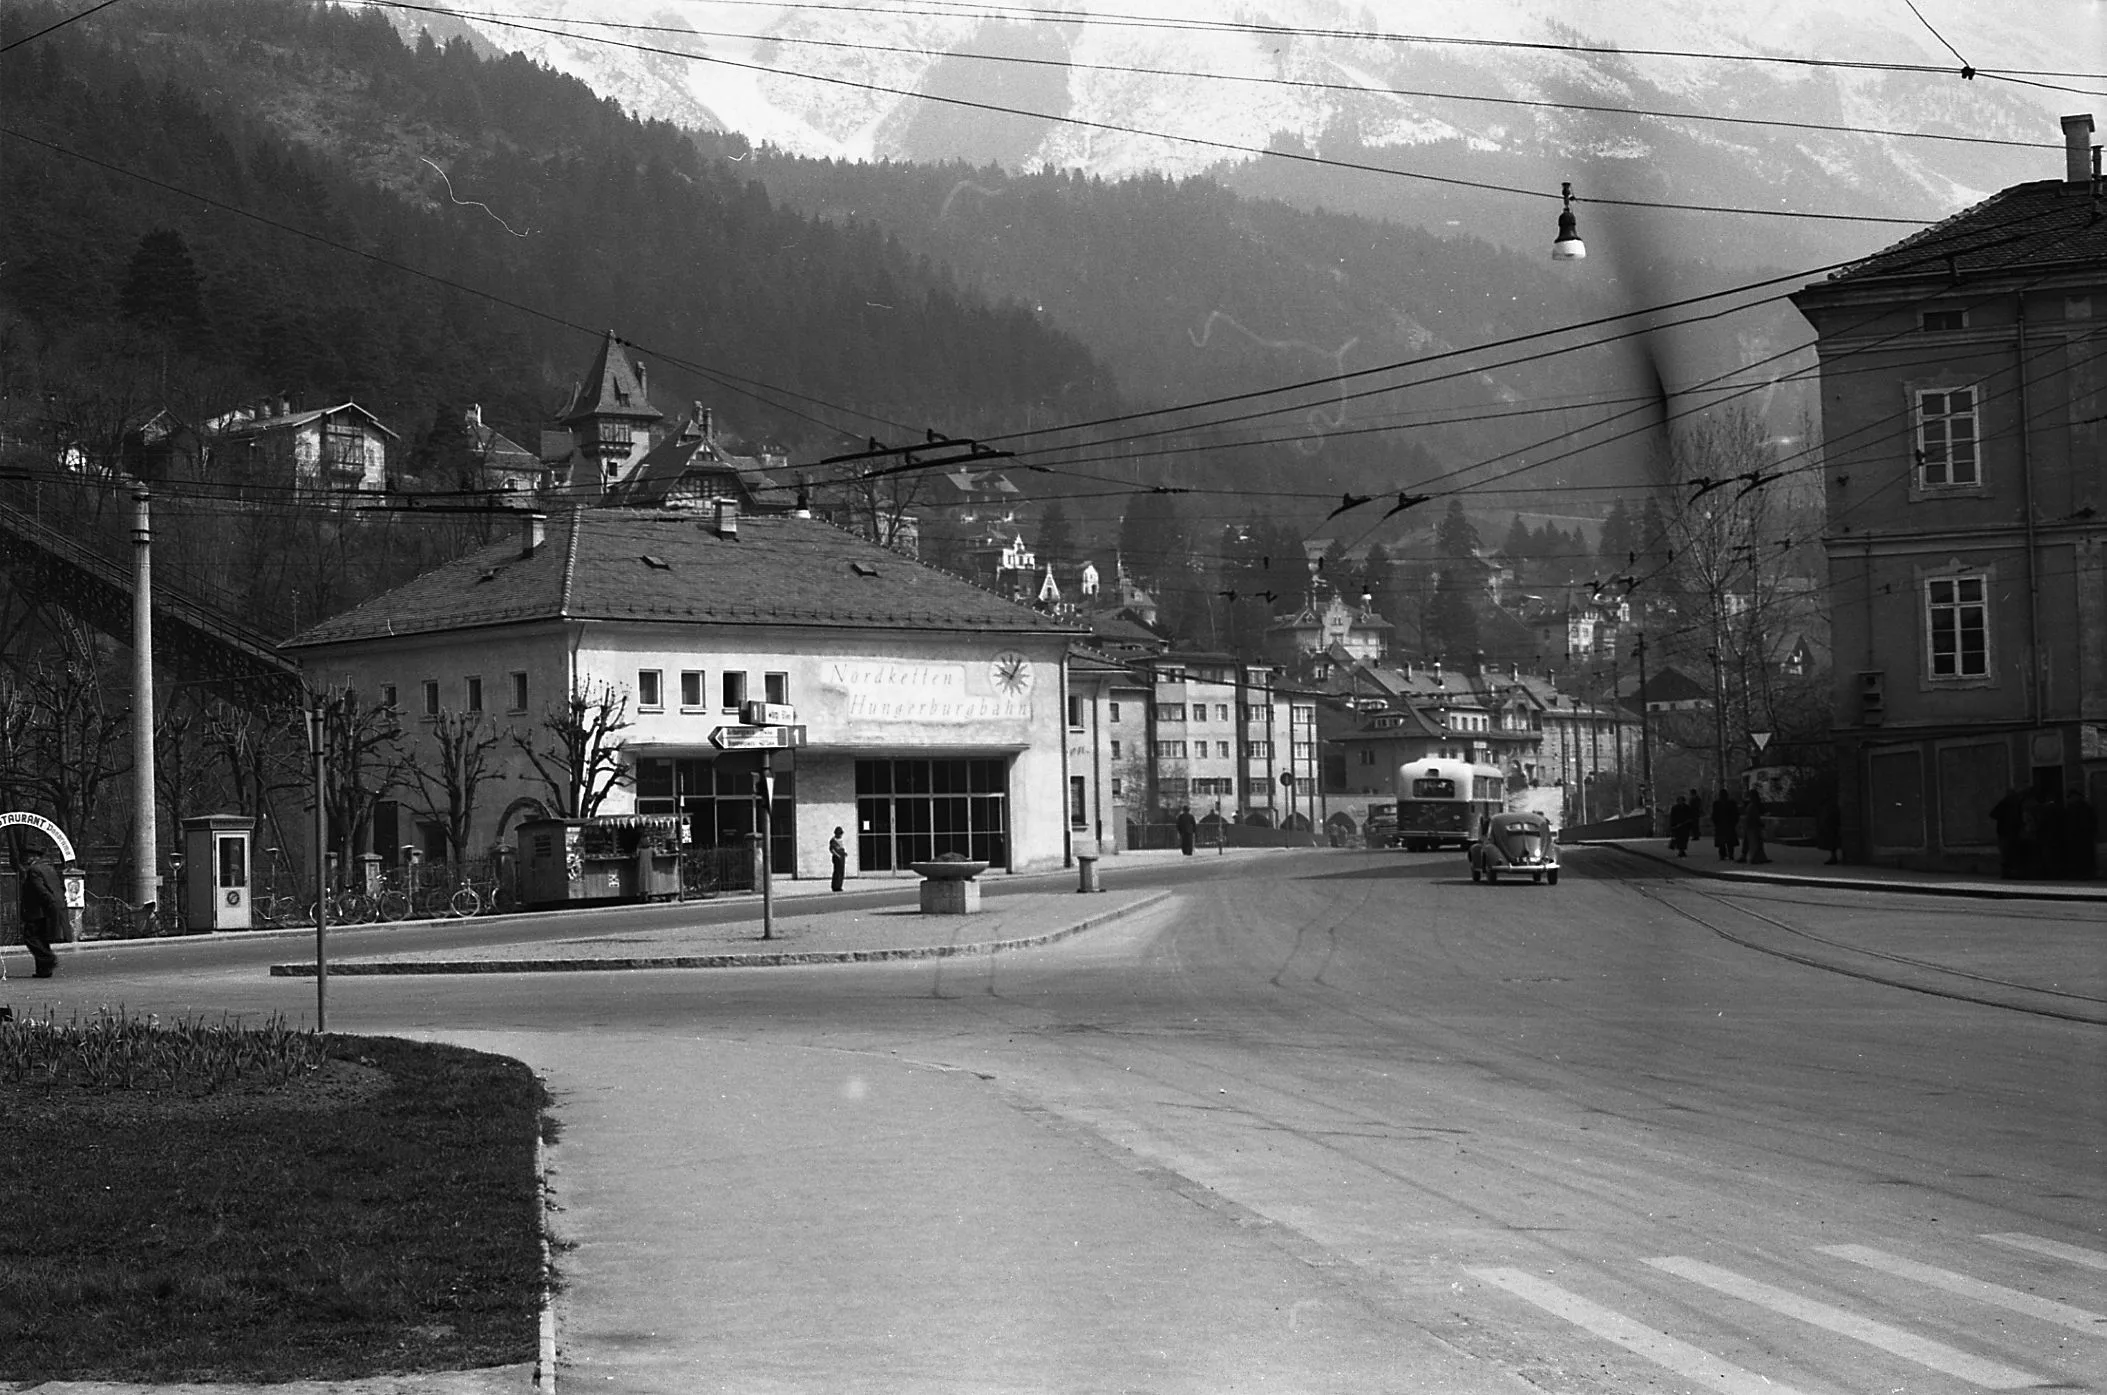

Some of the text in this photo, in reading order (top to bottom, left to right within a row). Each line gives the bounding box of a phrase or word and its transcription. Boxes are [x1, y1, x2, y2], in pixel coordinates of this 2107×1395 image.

[753, 704, 758, 721] 1
[849, 693, 1027, 719] Hungerburgbahn
[793, 728, 800, 745] 1
